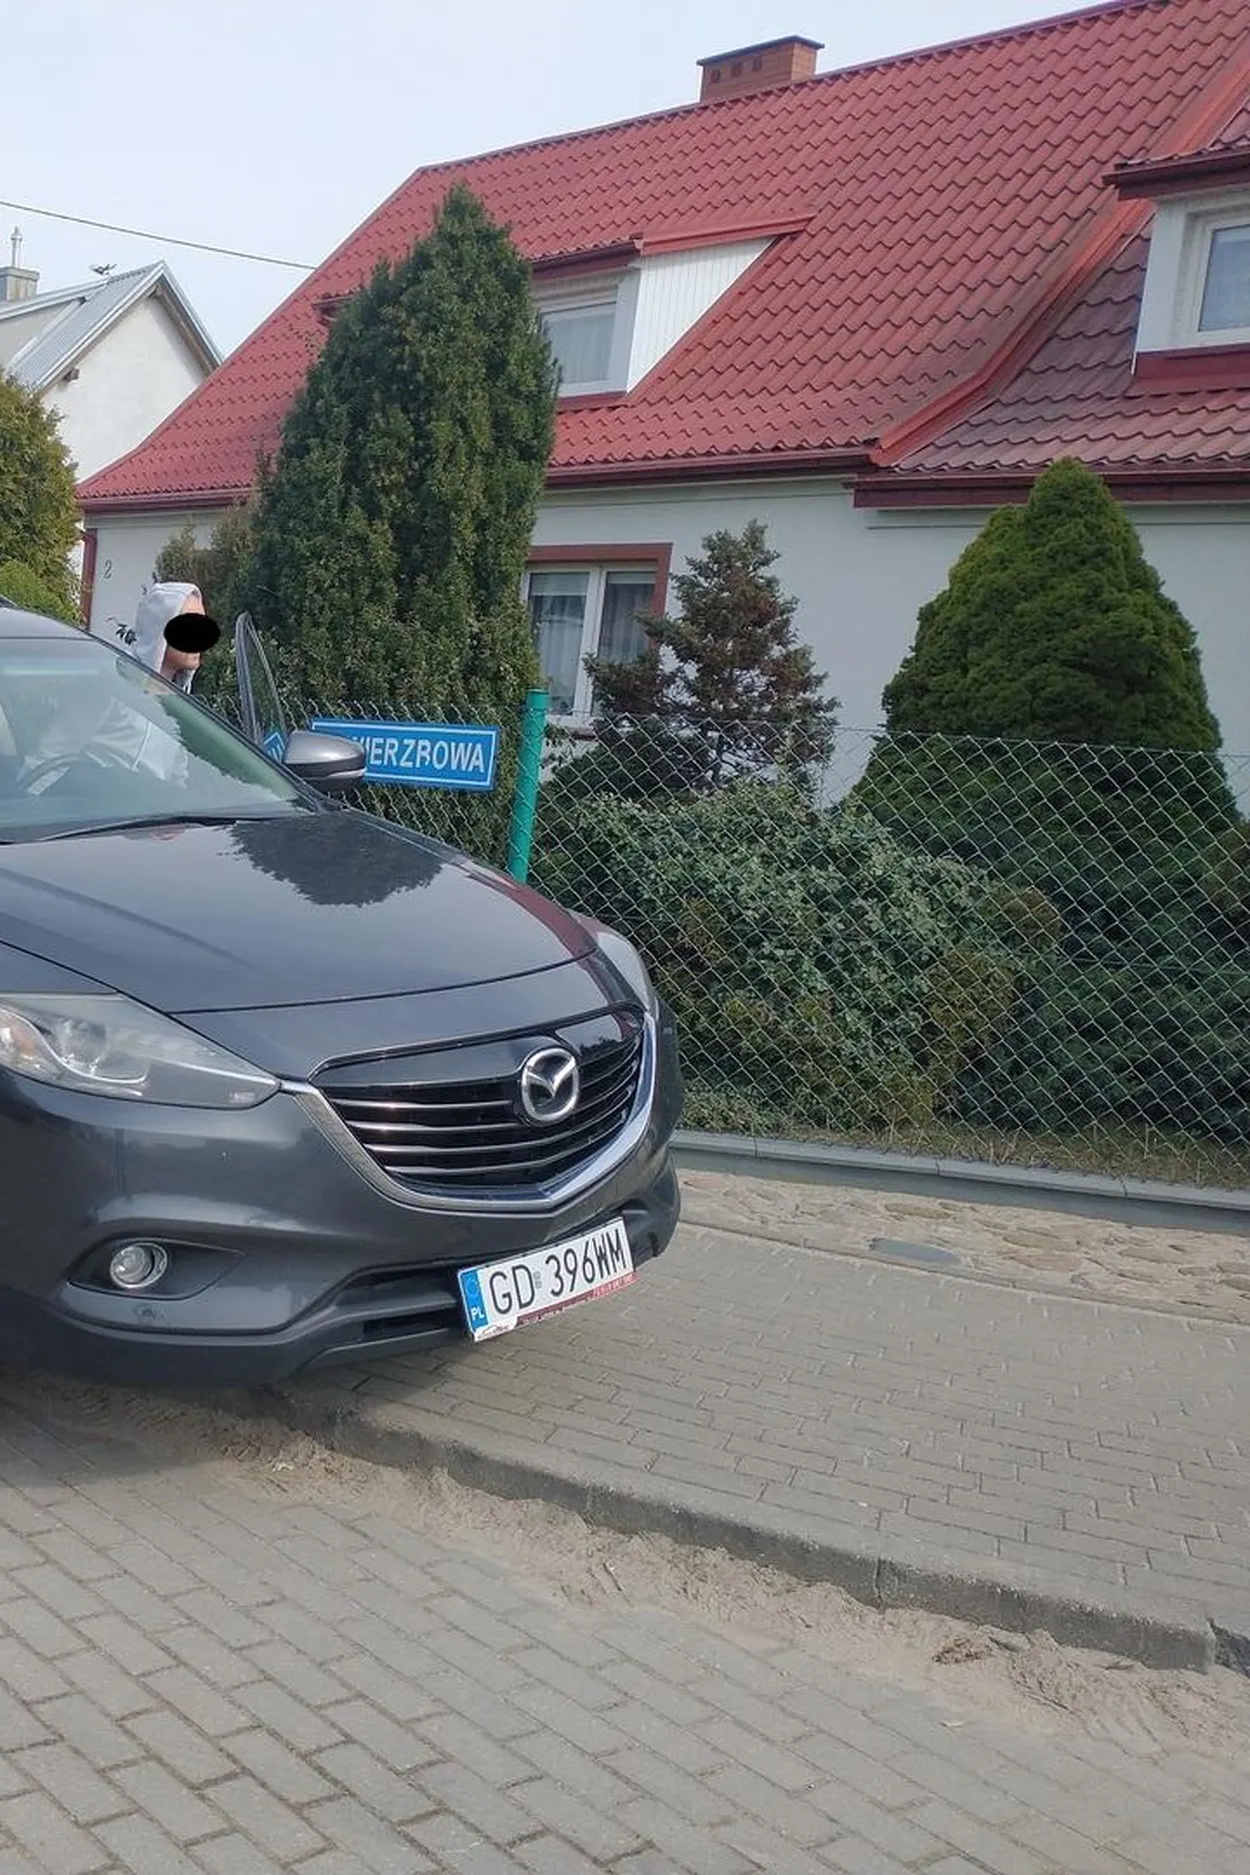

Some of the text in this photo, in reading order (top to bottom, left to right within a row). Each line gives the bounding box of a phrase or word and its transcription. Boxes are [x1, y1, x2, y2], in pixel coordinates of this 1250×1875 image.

[489, 1264, 536, 1315] GD
[545, 1228, 627, 1297] 396WM
[470, 1305, 486, 1322] PL
